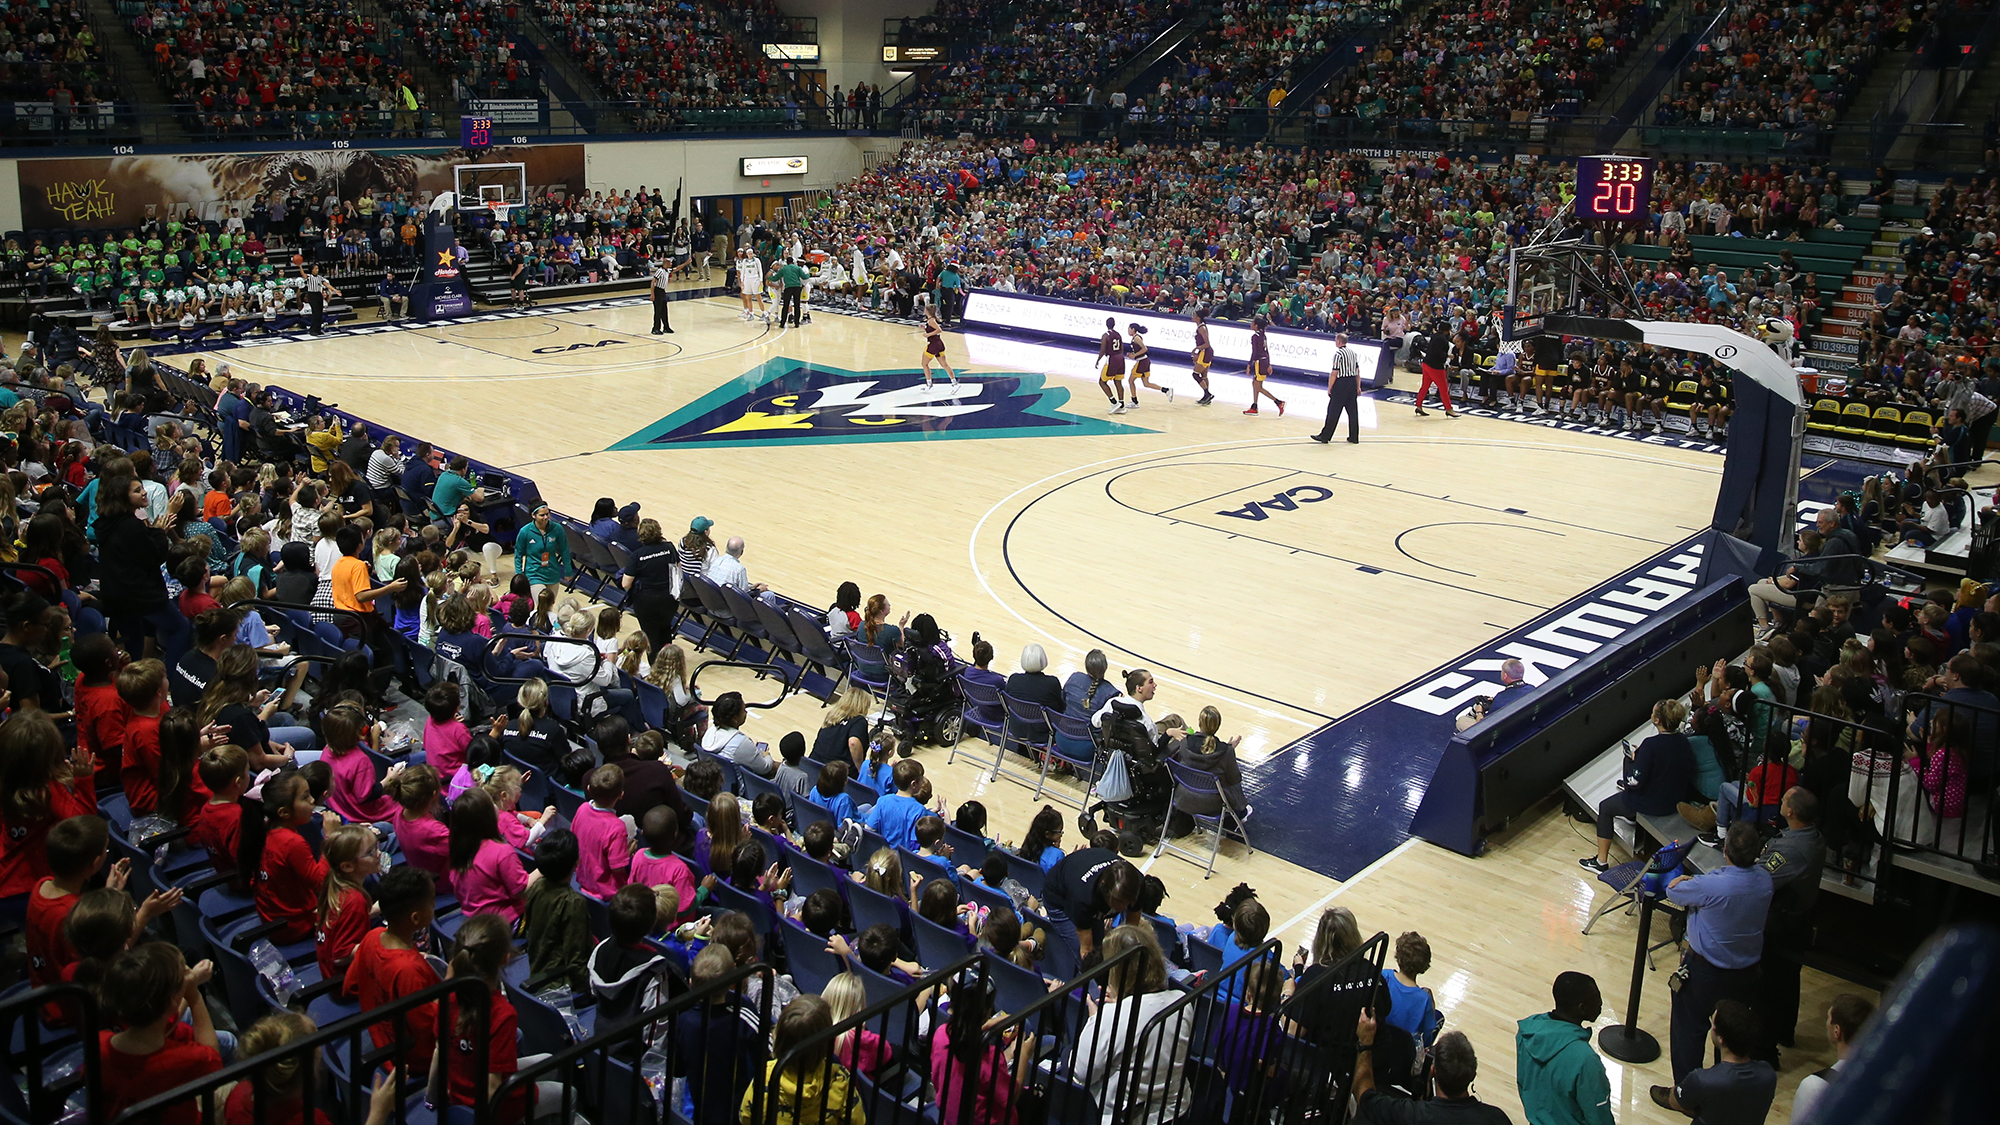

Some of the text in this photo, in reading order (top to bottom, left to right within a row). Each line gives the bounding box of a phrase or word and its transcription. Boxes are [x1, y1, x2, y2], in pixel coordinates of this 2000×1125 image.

[473, 120, 491, 130] 3:33
[471, 129, 488, 145] 20
[113, 146, 134, 154] 104
[331, 140, 349, 149] 105
[1349, 148, 1381, 157] NORTH
[1602, 163, 1643, 182] 3:33
[47, 179, 109, 204] HAWK
[1593, 182, 1636, 214] 20
[54, 193, 115, 221] YEAH!
[1856, 292, 1875, 301] STR
[1848, 309, 1870, 318] BLOC
[975, 302, 1011, 314] PANDORA
[1063, 314, 1103, 327] PANDORA
[1159, 326, 1197, 340] PANDOR
[1269, 341, 1318, 358] PANDORA
[532, 339, 629, 354] CAA
[1812, 340, 1859, 354] 910.395.08
[1811, 359, 1849, 371] VILLAGES
[1680, 383, 1697, 393] UNCW
[1819, 401, 1837, 410] UNCW
[1849, 404, 1867, 414] UNCW
[1879, 409, 1897, 419] UNCW
[1909, 412, 1929, 423] UNCW
[1386, 395, 1727, 454] @UNCWATHLETI
[1214, 485, 1334, 521] CAA
